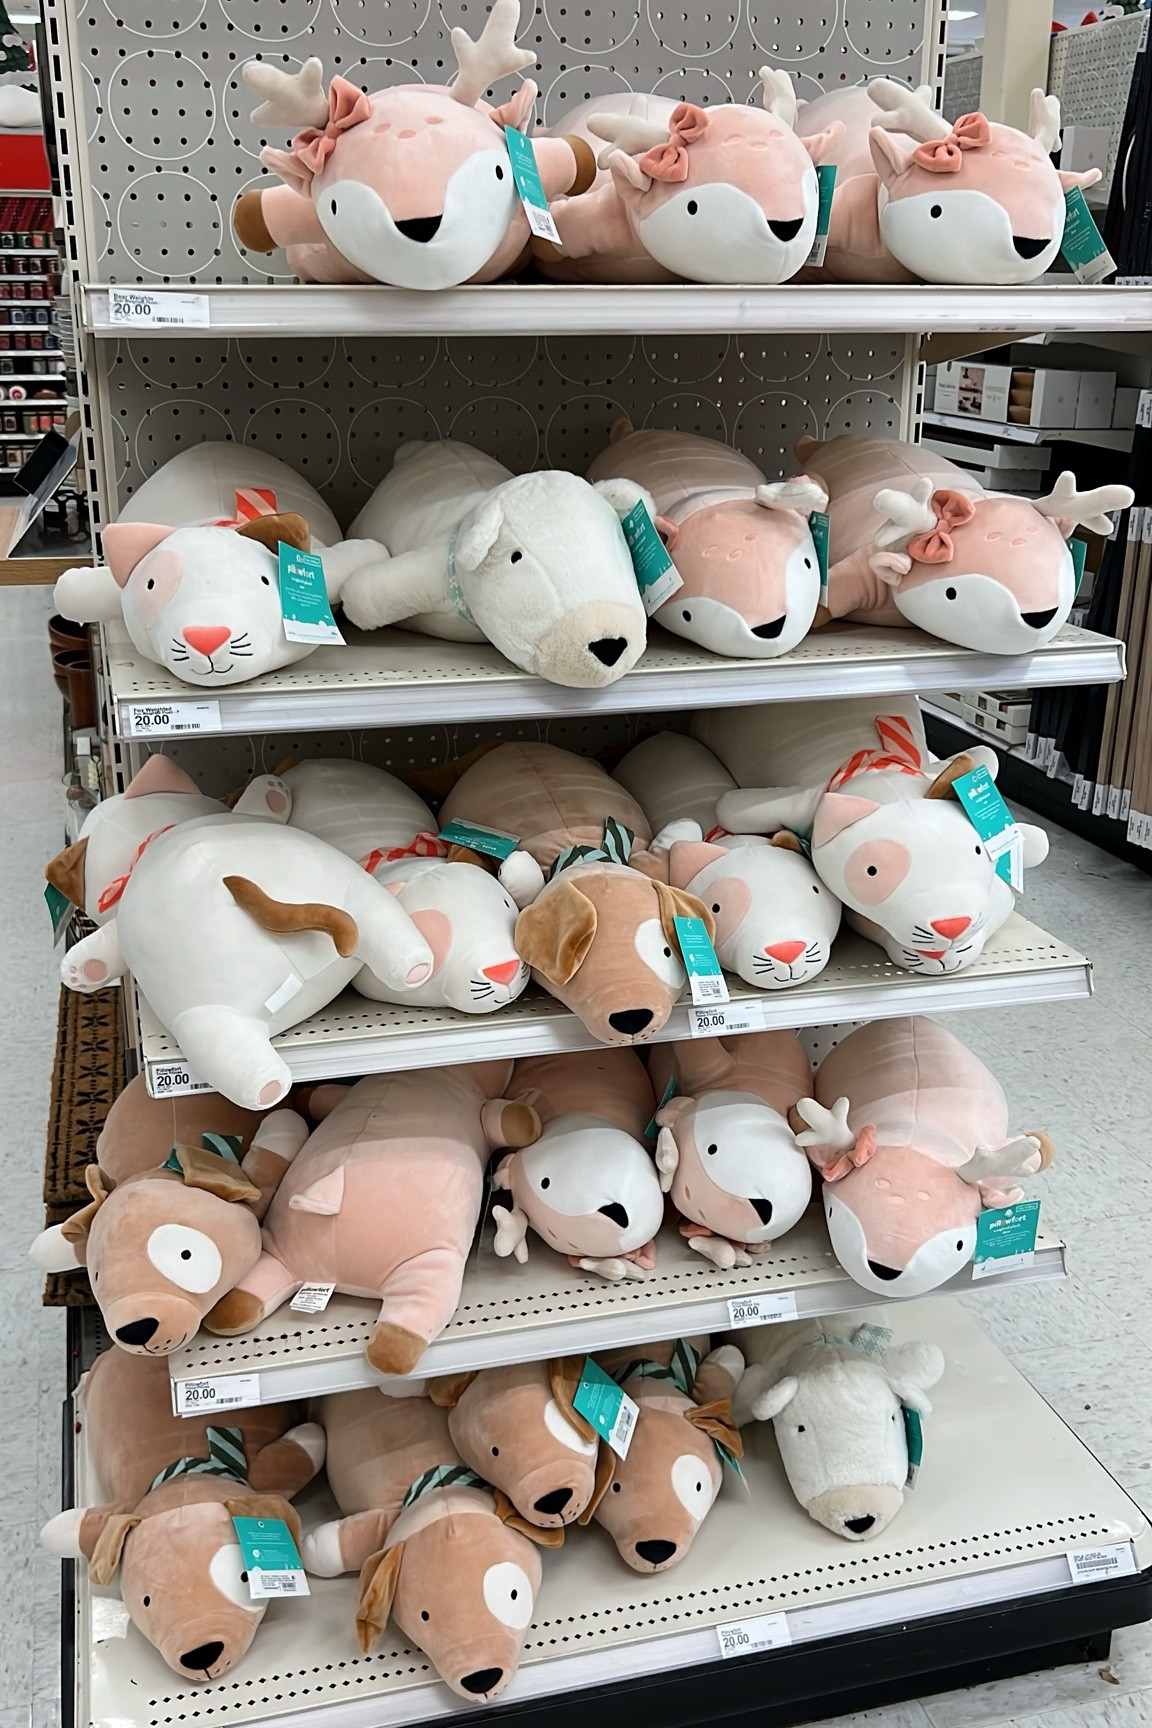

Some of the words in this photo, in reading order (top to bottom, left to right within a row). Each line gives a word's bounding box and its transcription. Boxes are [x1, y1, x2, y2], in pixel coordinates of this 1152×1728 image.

[114, 303, 151, 316] 20.00
[135, 714, 169, 726] 20.00
[696, 1015, 725, 1028] 20.00
[157, 1073, 189, 1087] 20.00
[989, 1214, 1027, 1231] pillowfort
[733, 1305, 759, 1318] 20.00
[185, 1388, 216, 1401] 20.00
[723, 1633, 750, 1648] 20.00
